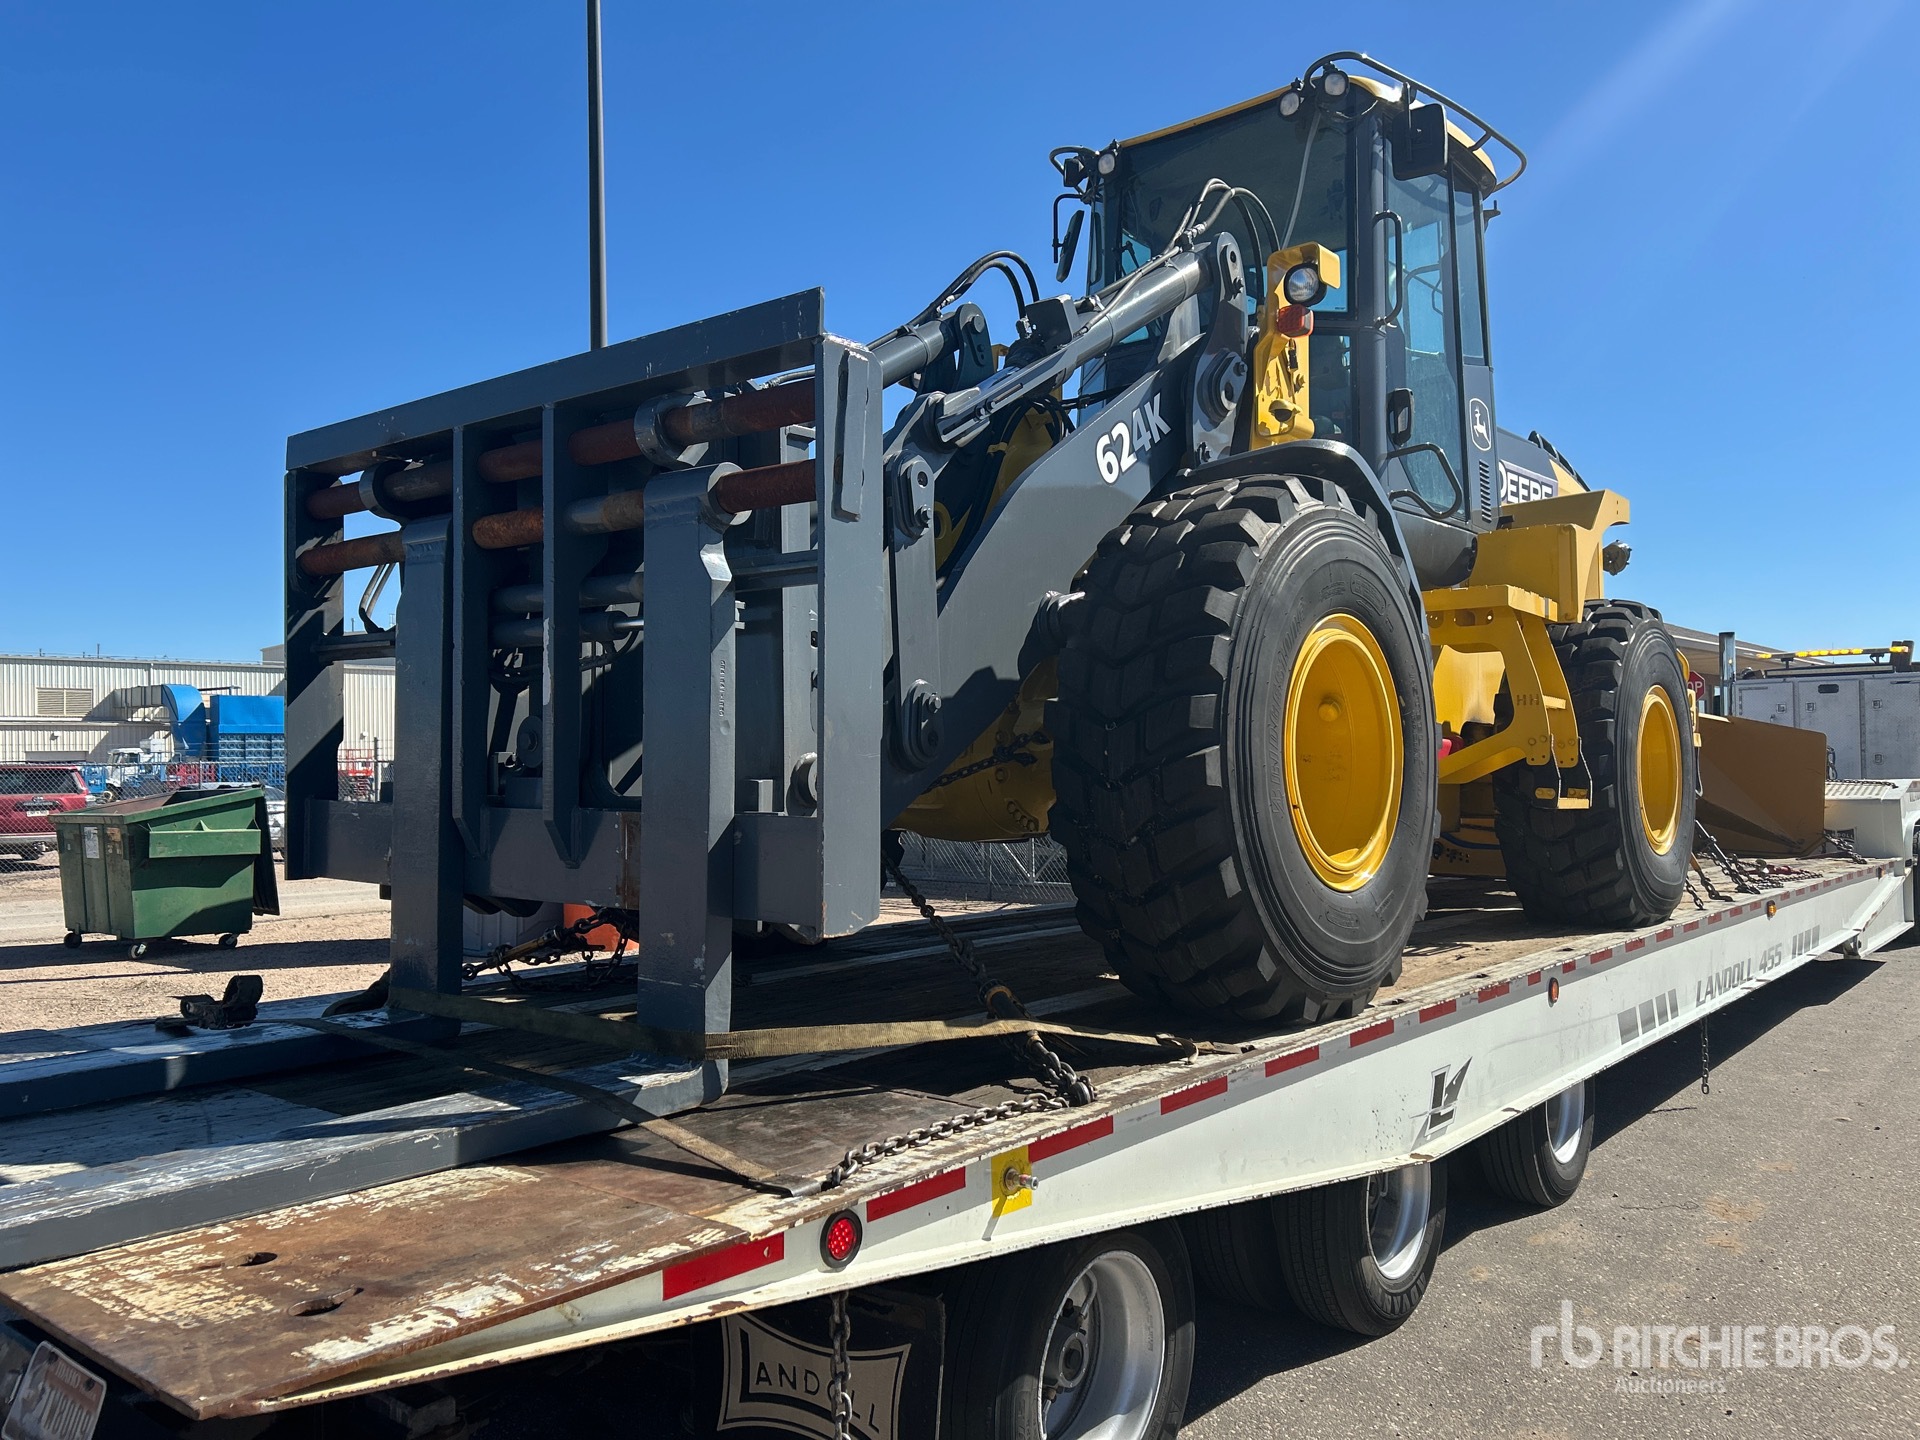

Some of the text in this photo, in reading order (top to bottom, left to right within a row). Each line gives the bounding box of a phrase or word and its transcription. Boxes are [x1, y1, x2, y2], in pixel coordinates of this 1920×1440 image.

[1095, 391, 1172, 485] 624K
[1687, 681, 1703, 694] OP
[1695, 942, 1783, 1008] LANDOLL 455
[55, 1360, 81, 1389] IDAHO
